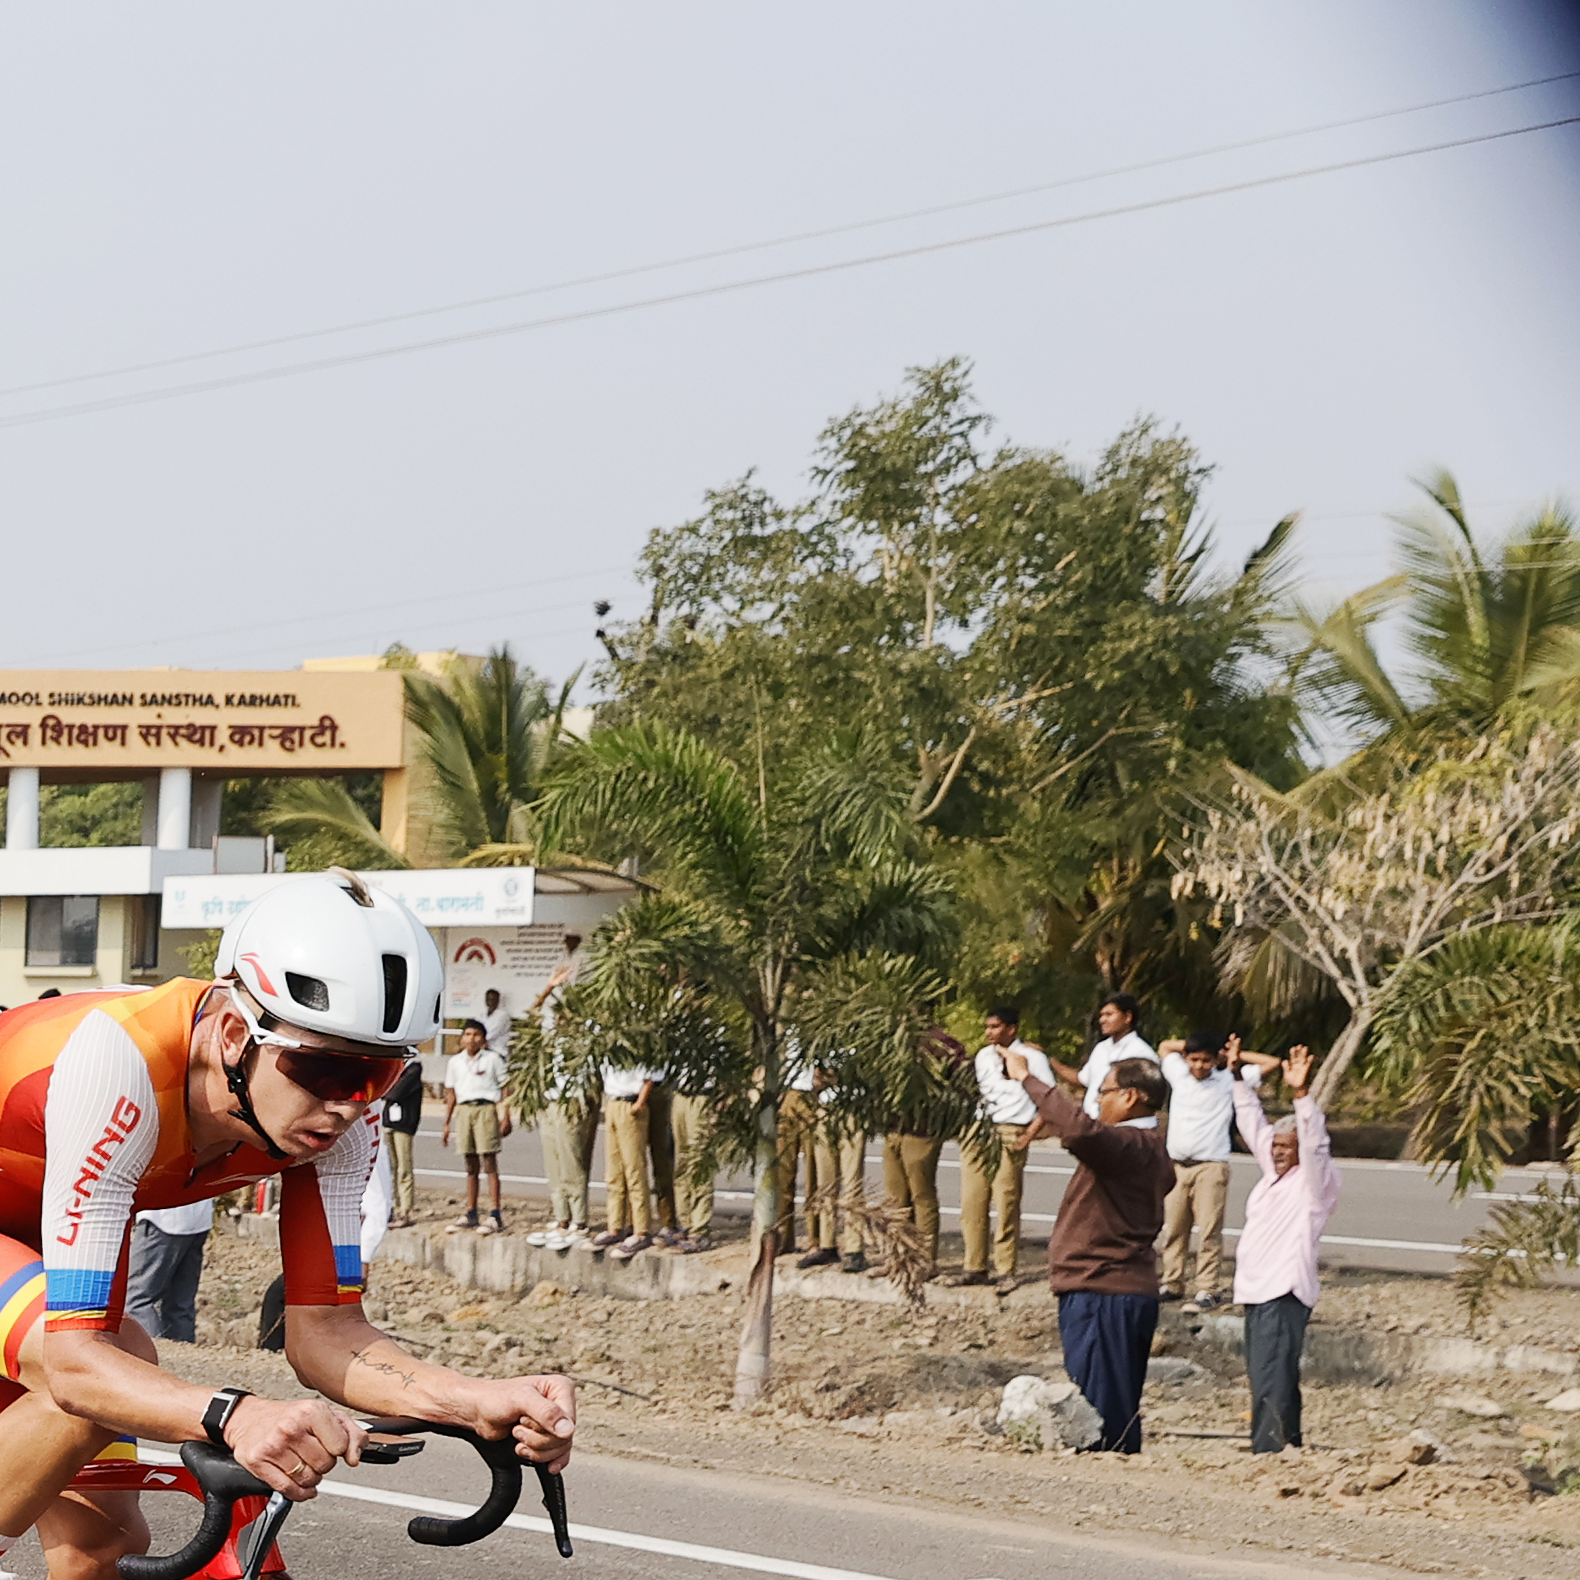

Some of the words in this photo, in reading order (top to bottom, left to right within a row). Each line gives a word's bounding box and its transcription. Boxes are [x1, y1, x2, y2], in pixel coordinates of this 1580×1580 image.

[47, 692, 134, 708] SHIKSHAN
[139, 692, 220, 710] SANSTHA,
[224, 693, 301, 708] KARHATI.
[38, 714, 129, 748] शिक्षण
[55, 1095, 141, 1247] LI-NING
